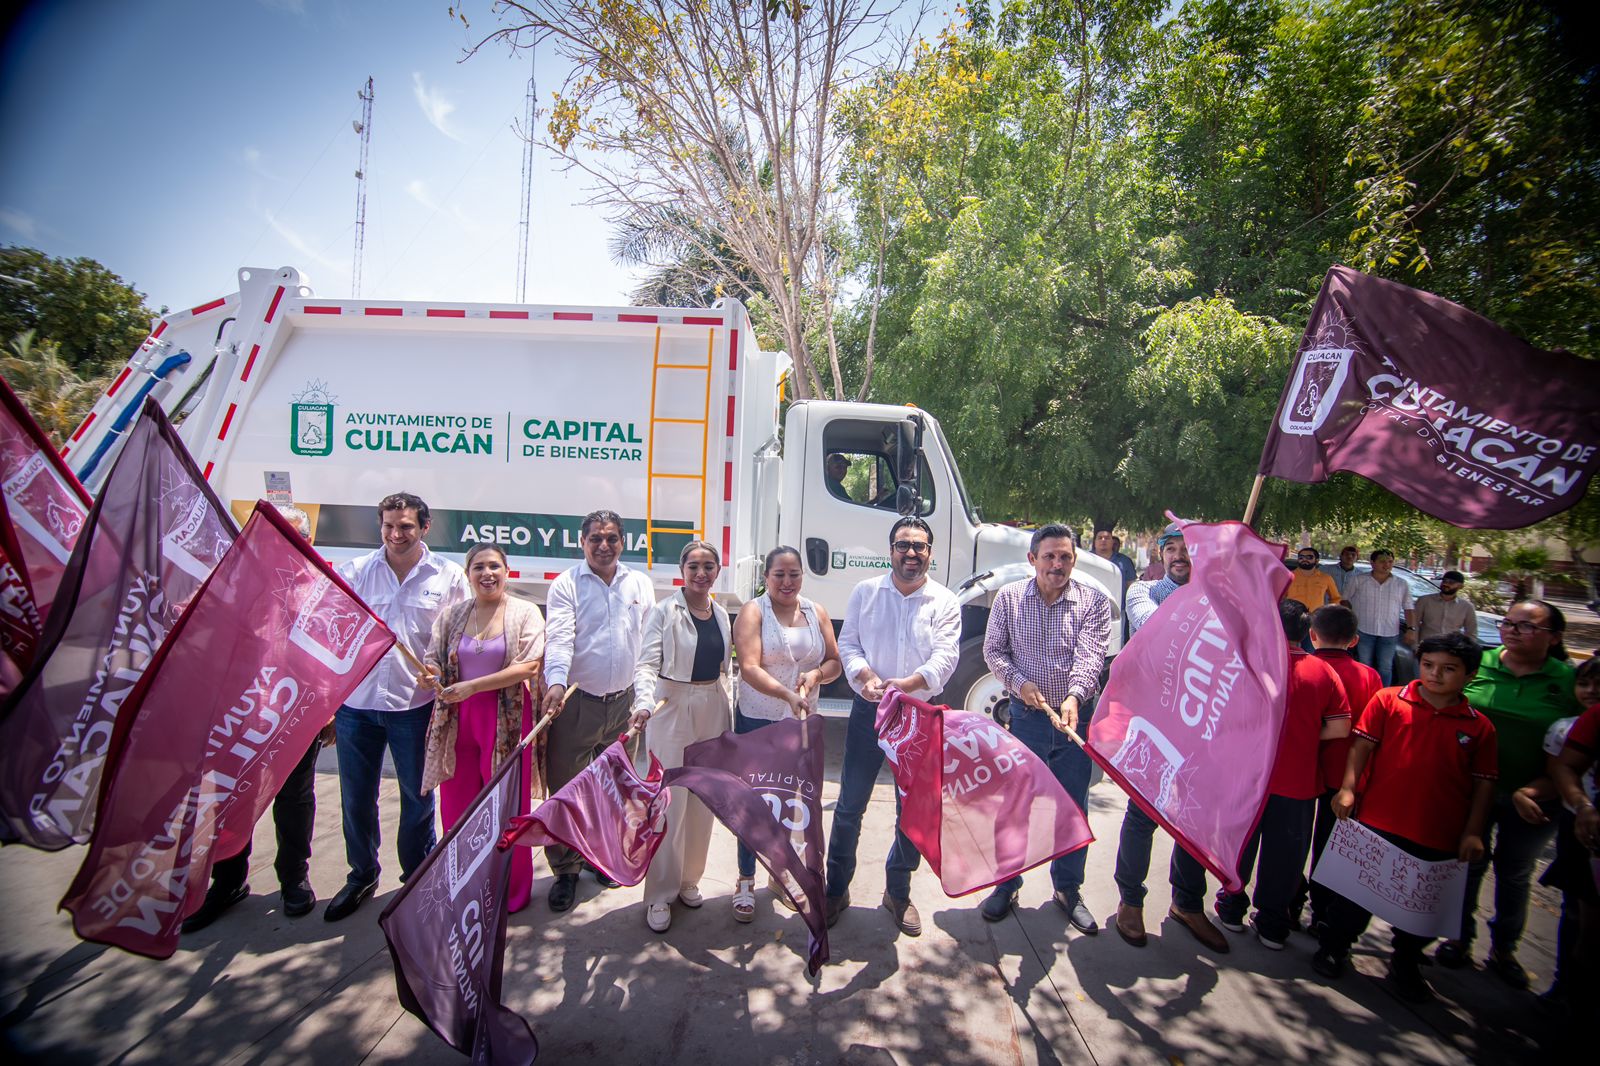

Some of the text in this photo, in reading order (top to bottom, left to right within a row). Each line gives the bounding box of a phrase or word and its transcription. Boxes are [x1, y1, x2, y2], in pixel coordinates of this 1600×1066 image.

[346, 413, 492, 428] AYUNTAMIENTO DE
[523, 419, 643, 443] CAPITAL
[345, 429, 493, 455] CULIACÁN
[523, 445, 642, 461] DE BIENESTAR
[1561, 444, 1597, 463] DE
[1417, 427, 1438, 447] DE
[1436, 453, 1545, 506] BIENESTAR
[461, 524, 654, 552] ASEO Y LIIA
[748, 772, 814, 793] CAPITAL
[1330, 841, 1381, 877] TECHOS
[1336, 825, 1359, 844] NOS
[1366, 844, 1385, 859] CON
[1392, 858, 1409, 875] LA
[1399, 853, 1420, 871] POR
